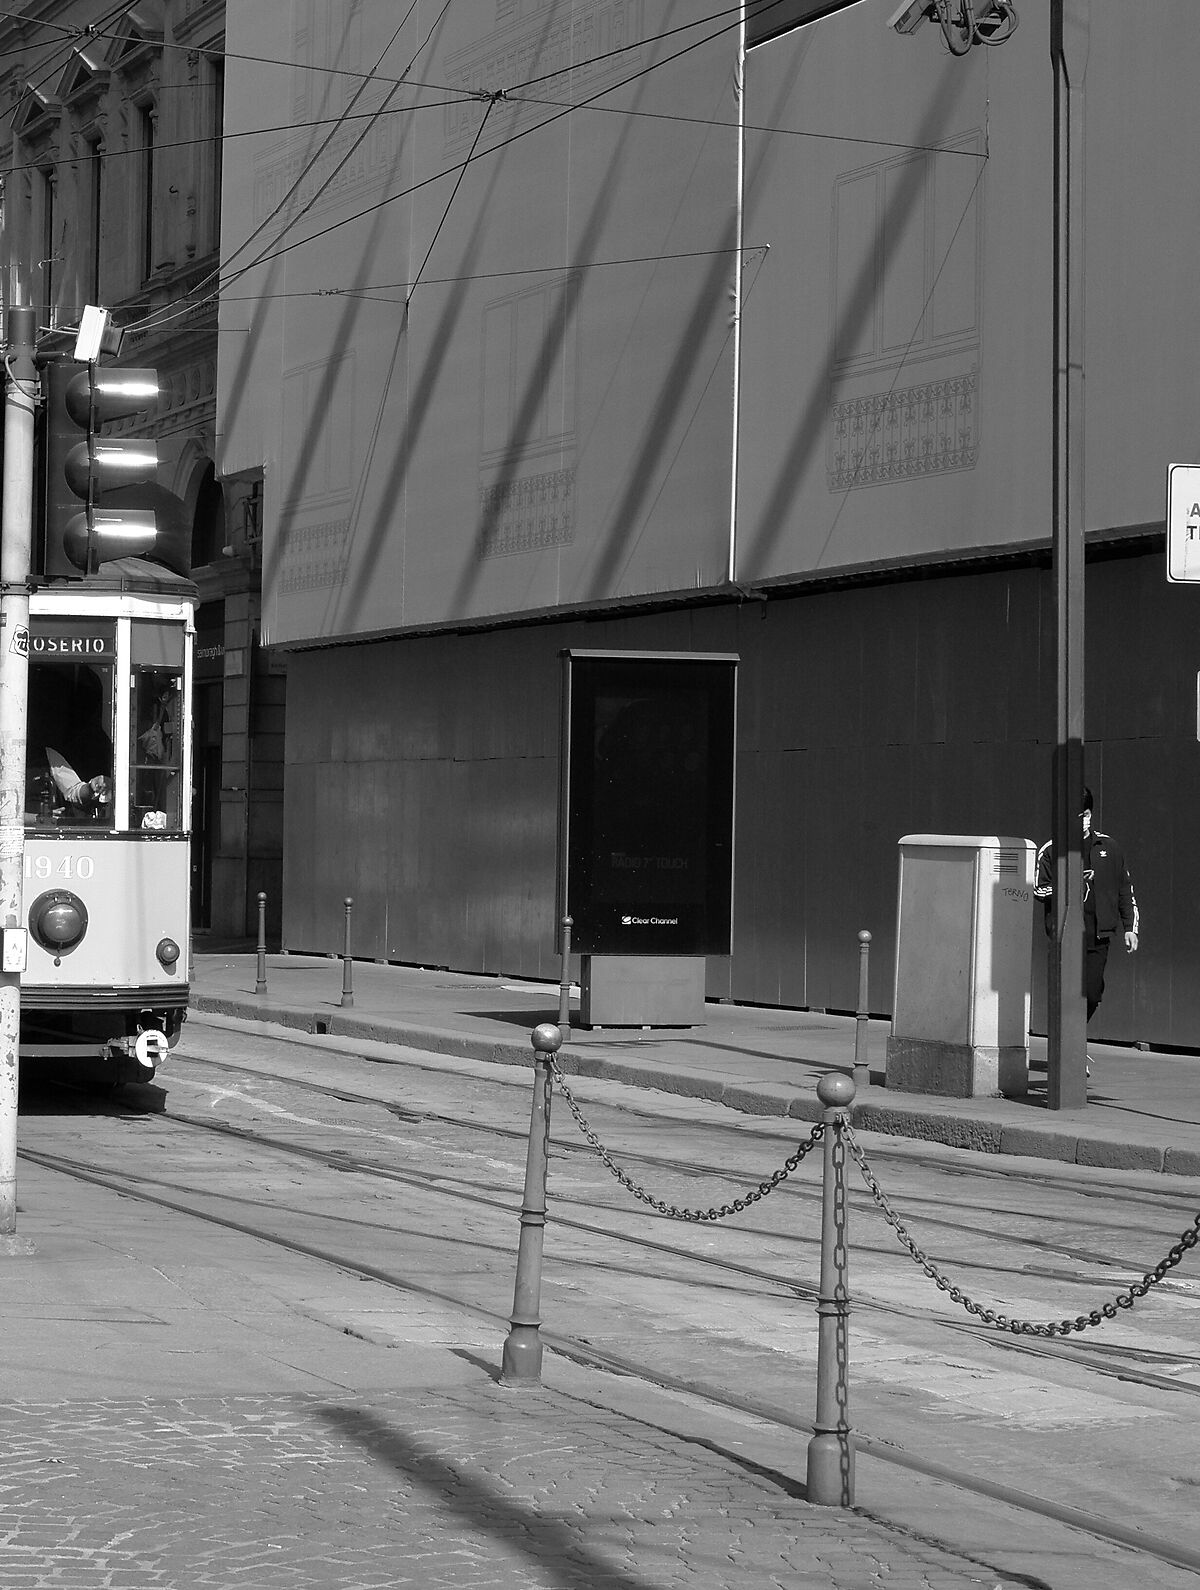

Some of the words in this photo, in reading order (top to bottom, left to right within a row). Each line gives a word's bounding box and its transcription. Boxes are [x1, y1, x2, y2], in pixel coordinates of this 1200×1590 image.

[1186, 525, 1200, 540] T
[29, 638, 105, 653] OSERIO
[24, 854, 95, 880] 1940
[631, 916, 650, 925] Clear
[650, 916, 678, 925] Channel
